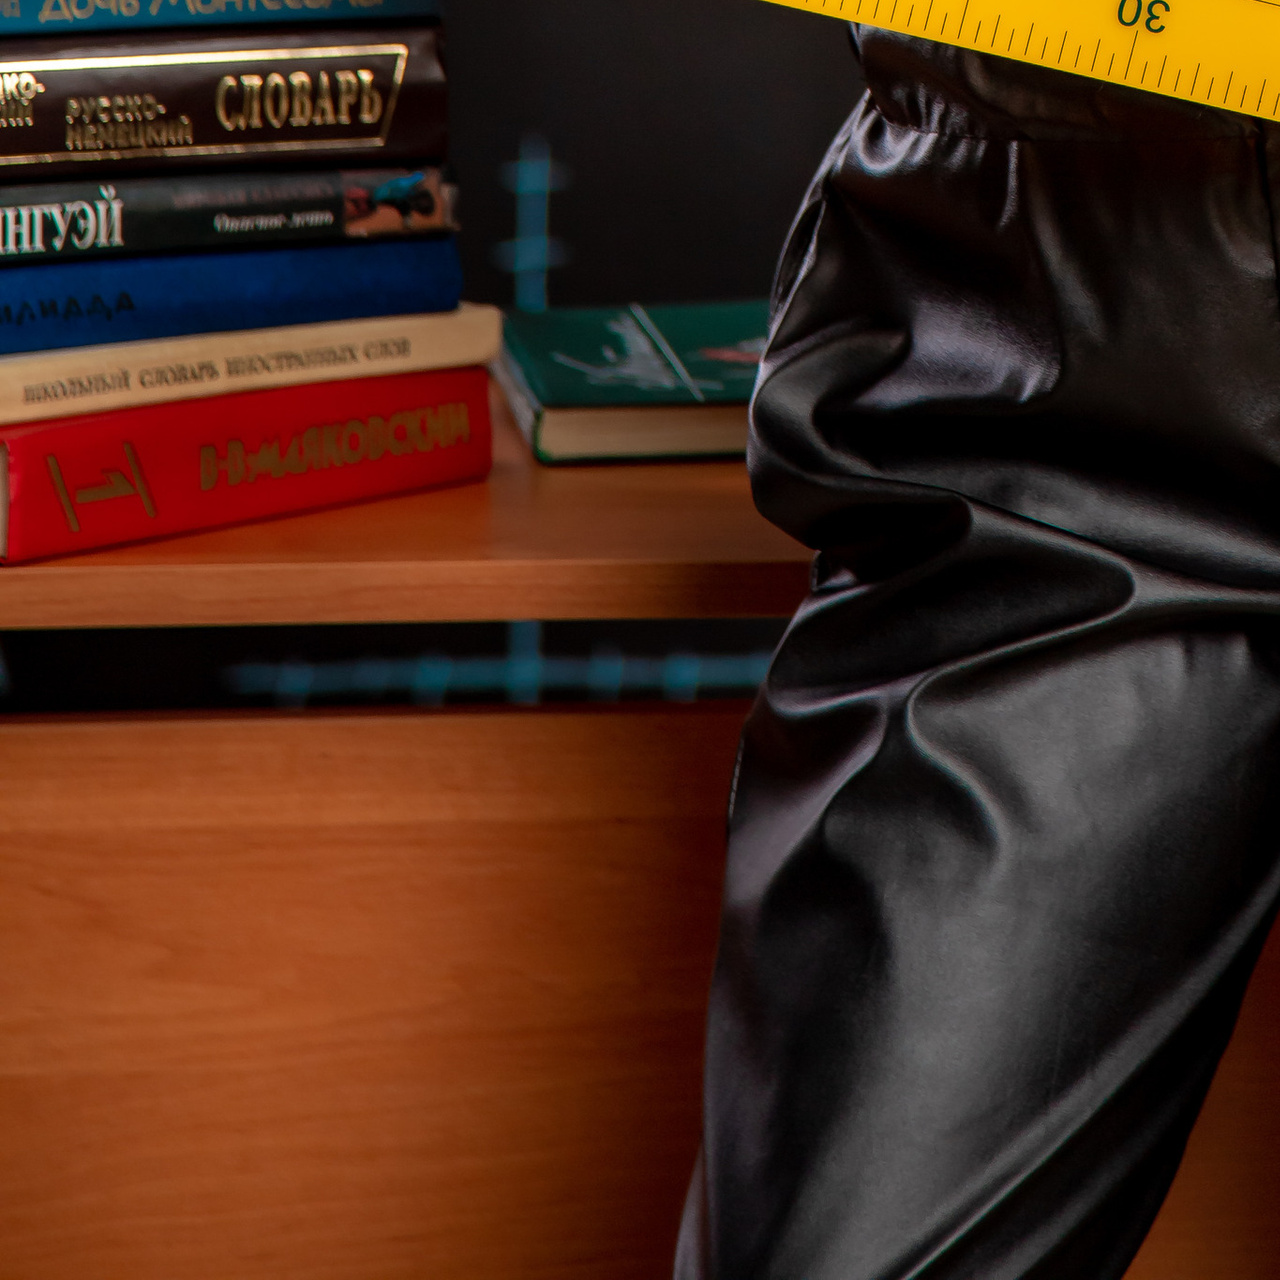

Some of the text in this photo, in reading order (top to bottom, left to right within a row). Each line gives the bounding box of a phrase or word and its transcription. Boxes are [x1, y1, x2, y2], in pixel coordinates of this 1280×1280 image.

[214, 68, 383, 132] СЛОВАРЬ
[0, 184, 124, 255] НГУЭЙ
[138, 359, 220, 389] СЛОВАРЬ
[225, 343, 359, 379] ИНОСТРАННЫХ
